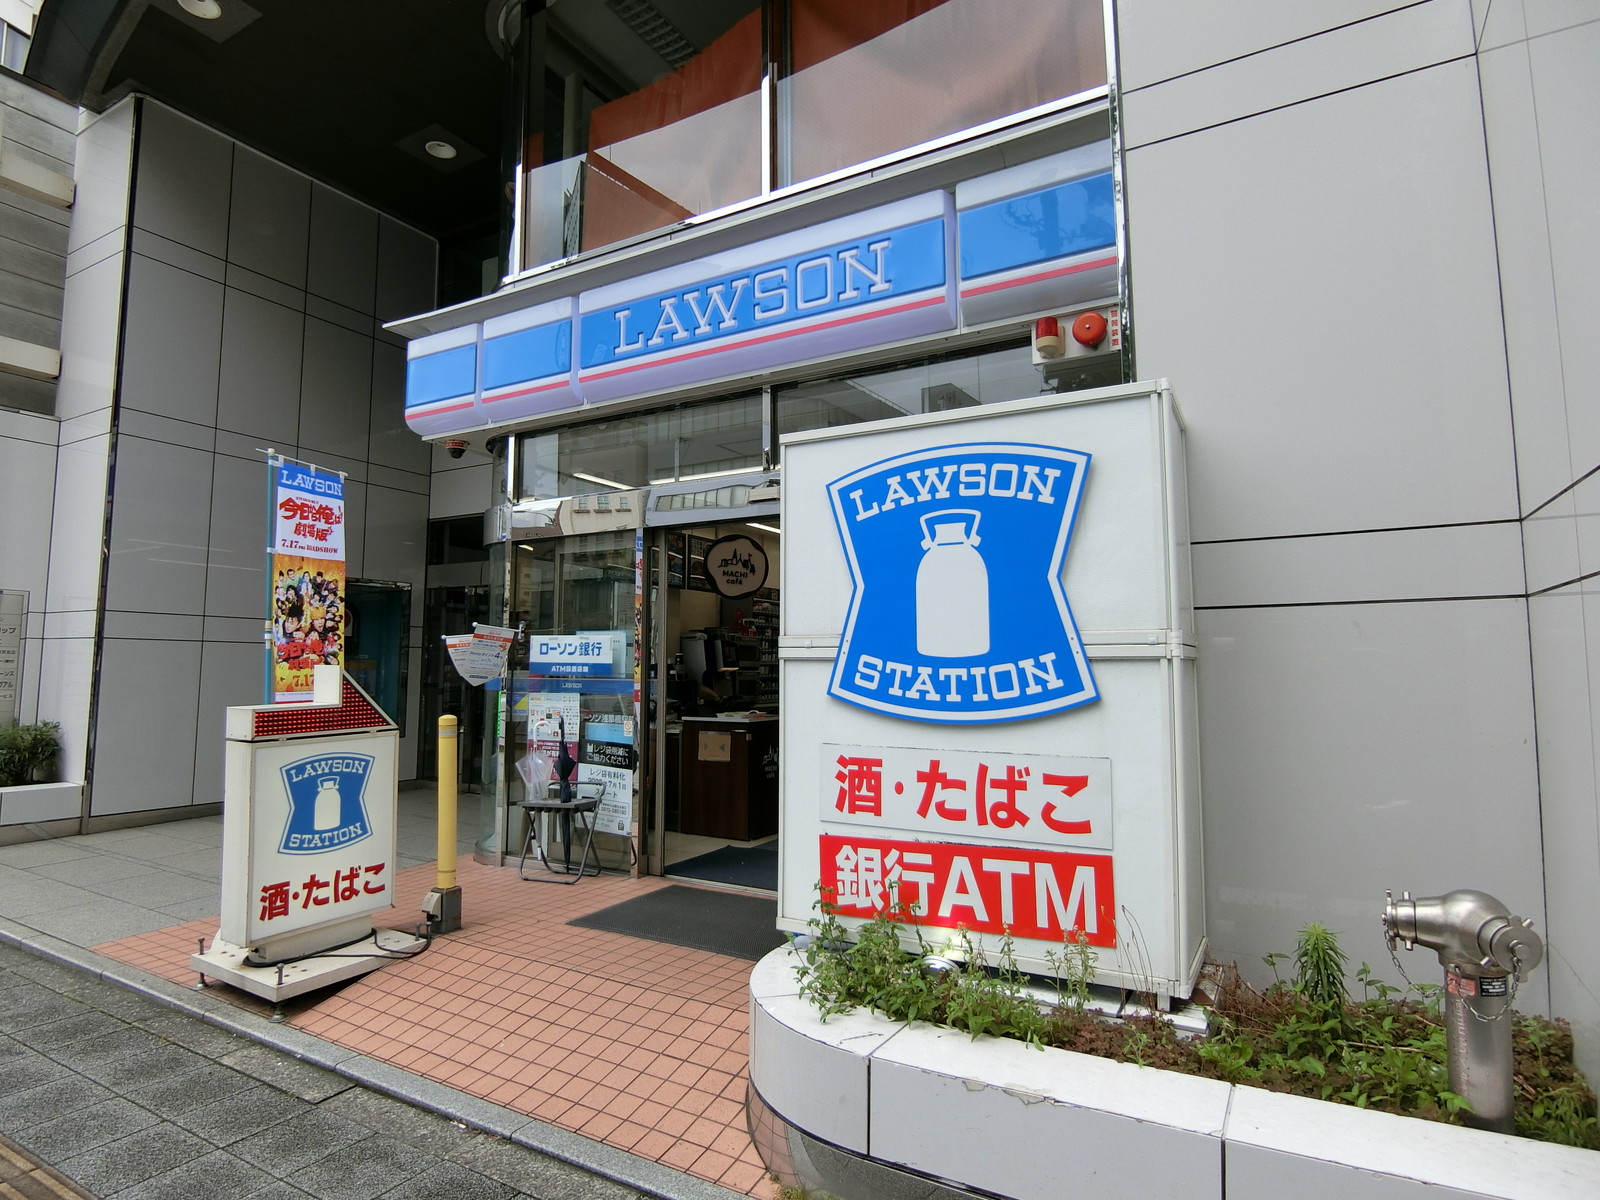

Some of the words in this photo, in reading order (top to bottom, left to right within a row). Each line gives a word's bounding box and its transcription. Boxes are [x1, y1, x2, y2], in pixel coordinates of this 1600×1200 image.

[613, 237, 892, 356] LAWSON
[280, 469, 343, 497] LAWSON
[849, 463, 1062, 522] LAWSON
[293, 521, 331, 542] 劇場版
[281, 538, 299, 549] 7.17
[306, 544, 339, 554] ROADSHOW
[722, 569, 748, 579] MACHI
[0, 626, 17, 634] ップ
[539, 641, 603, 657] ローソン銀行
[550, 665, 589, 673] ATM設置店舗
[854, 651, 1064, 702] STATION
[586, 752, 629, 765] ご協力ください
[290, 758, 366, 783] LAWSON
[589, 767, 626, 781] レジ袋有料化
[595, 787, 618, 799] スート
[834, 754, 1093, 834] 酒・たばこ
[289, 822, 363, 848] STATION
[259, 862, 386, 922] 酒・たばこ
[834, 844, 1099, 935] 銀行ATM
